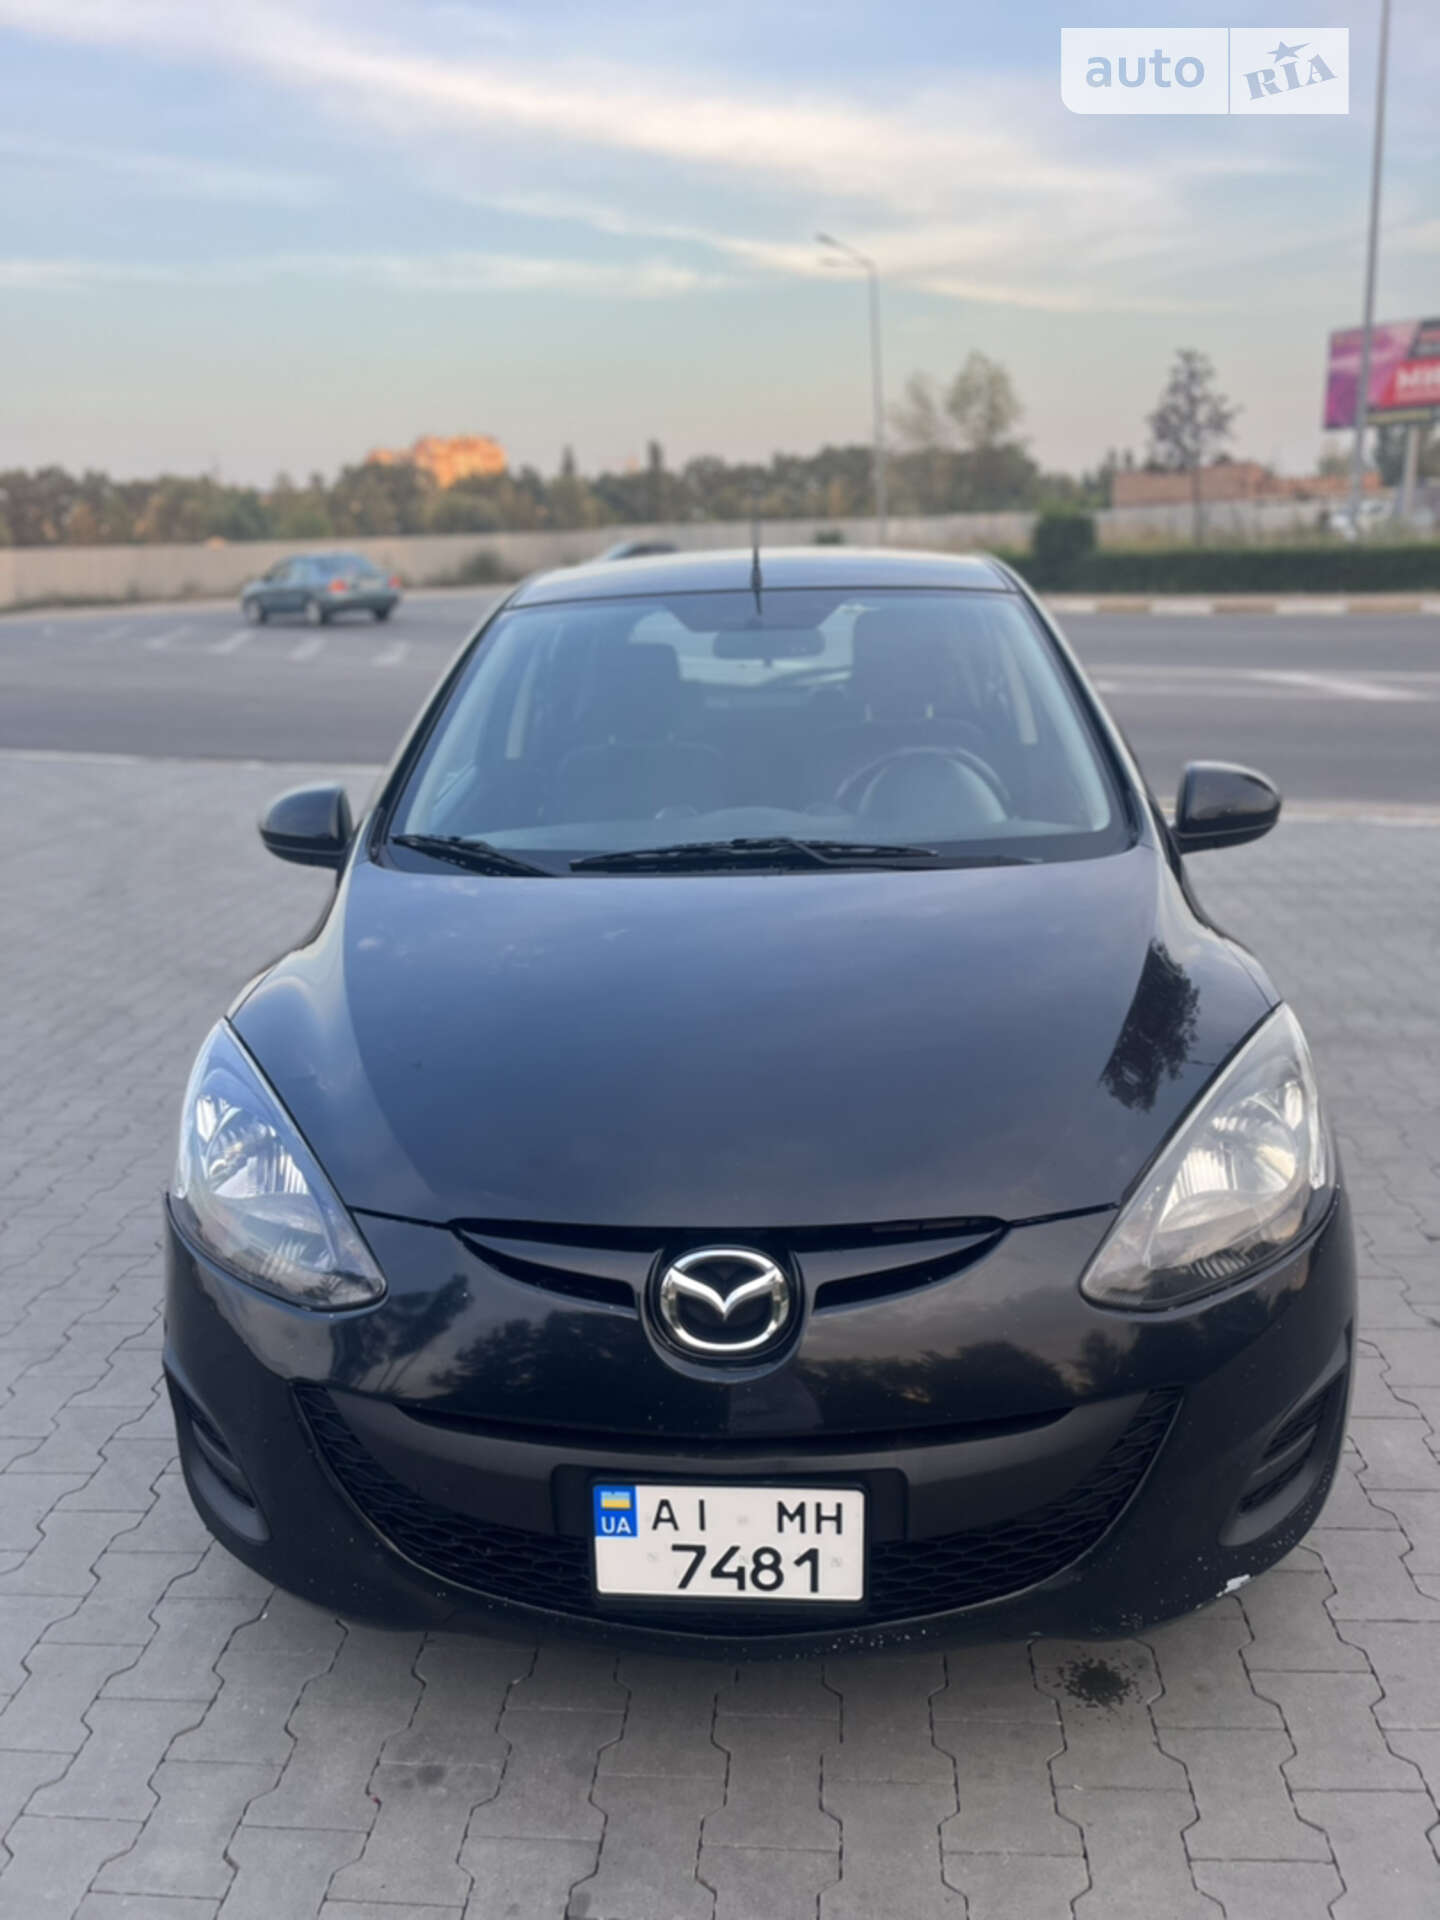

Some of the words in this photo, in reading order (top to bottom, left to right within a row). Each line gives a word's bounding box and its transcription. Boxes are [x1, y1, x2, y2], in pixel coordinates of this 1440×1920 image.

[601, 1517, 632, 1534] UA
[777, 1501, 842, 1534] MH
[671, 1544, 819, 1593] 7481
